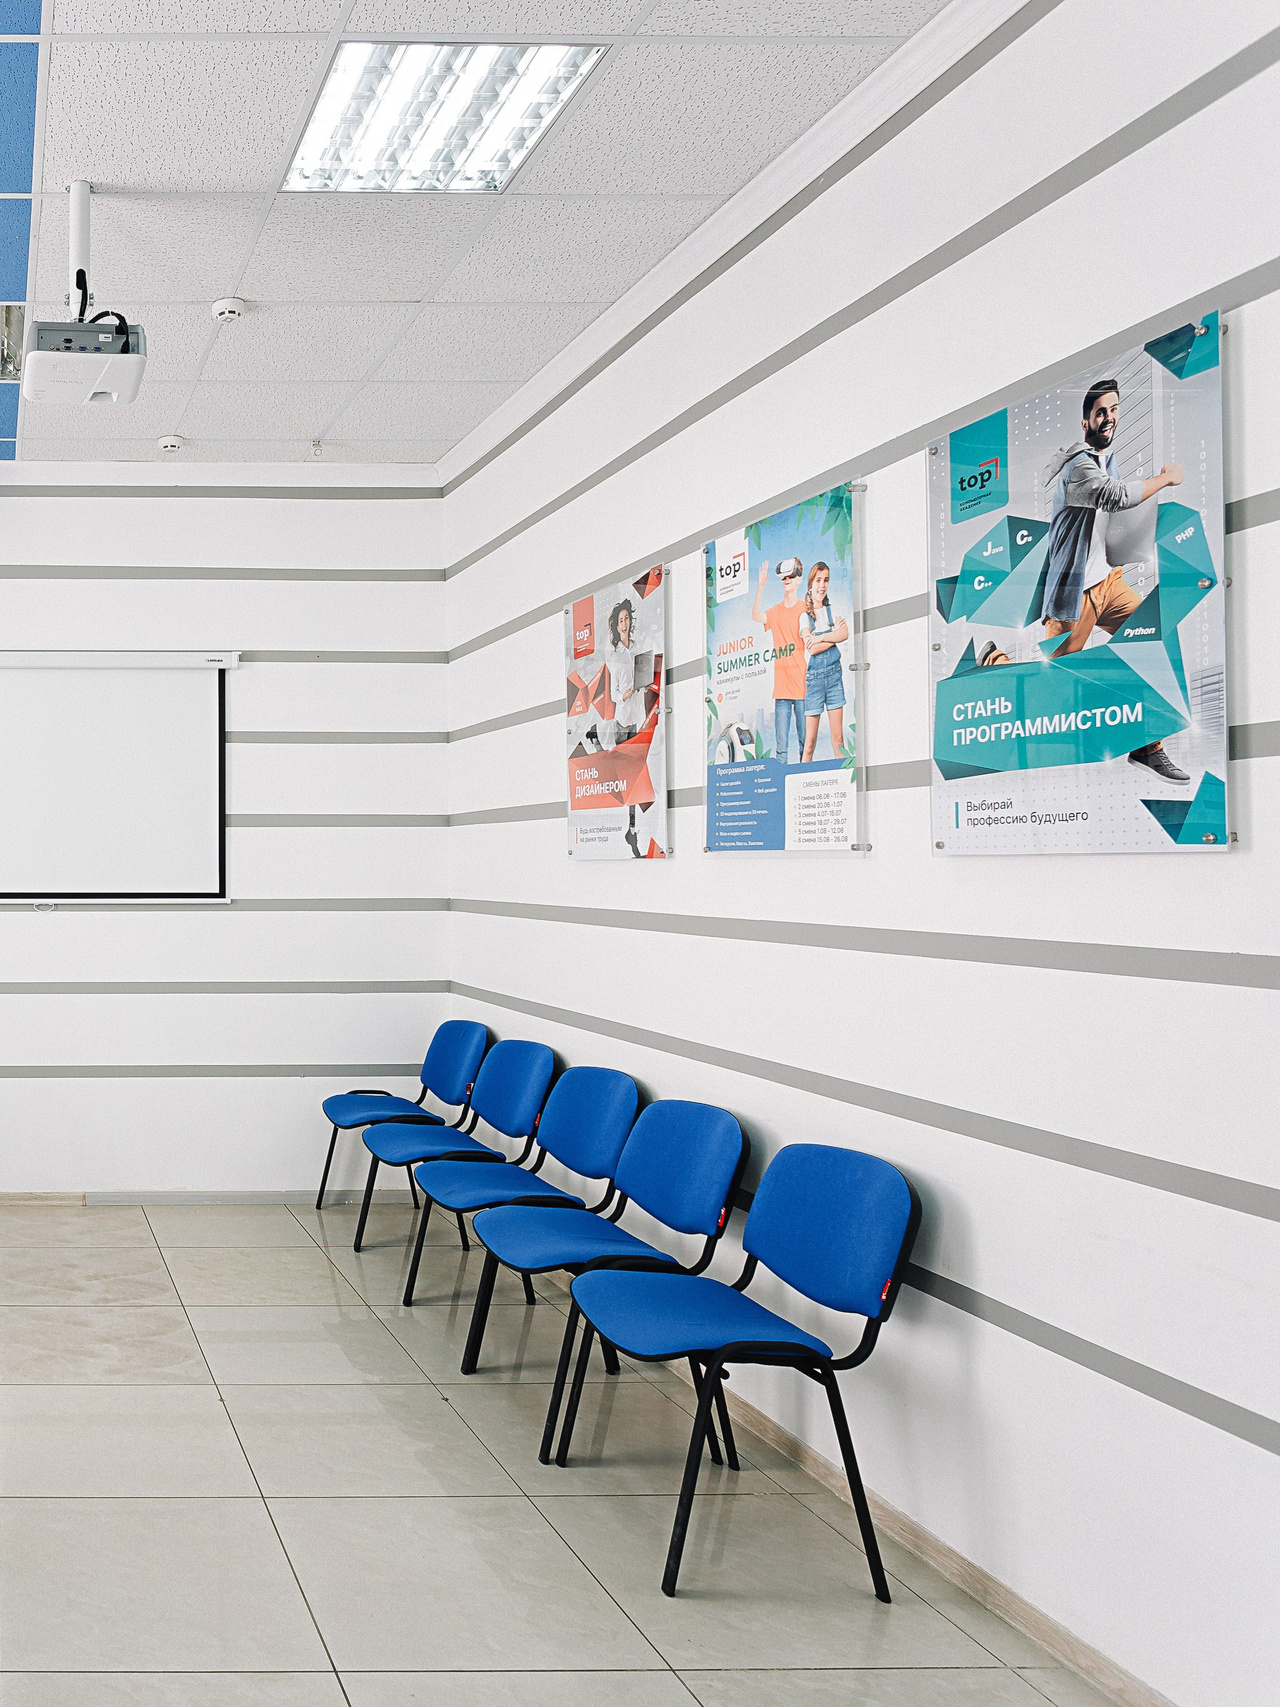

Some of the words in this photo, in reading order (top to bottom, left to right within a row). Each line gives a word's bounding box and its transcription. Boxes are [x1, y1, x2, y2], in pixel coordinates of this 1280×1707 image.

[959, 469, 992, 491] top
[1175, 526, 1195, 545] PHP
[719, 560, 741, 579] top
[974, 575, 993, 590] C++
[576, 628, 589, 641] top
[1124, 627, 1156, 638] Python
[717, 635, 754, 657] JUNIOR
[717, 654, 761, 675] SUMMER
[763, 643, 796, 663] CAMP
[717, 673, 740, 686] каникулы
[744, 667, 767, 679] пользой
[952, 696, 1012, 722] СТАНЬ
[952, 701, 1143, 746] ПРОГРАММИСТОМ
[575, 767, 599, 781] СТАНЬ
[575, 779, 627, 799] ДИЗАЙНЕРОМ
[966, 798, 1013, 812] Выбирай
[966, 812, 1028, 828] профессию
[1030, 809, 1089, 825] будущего
